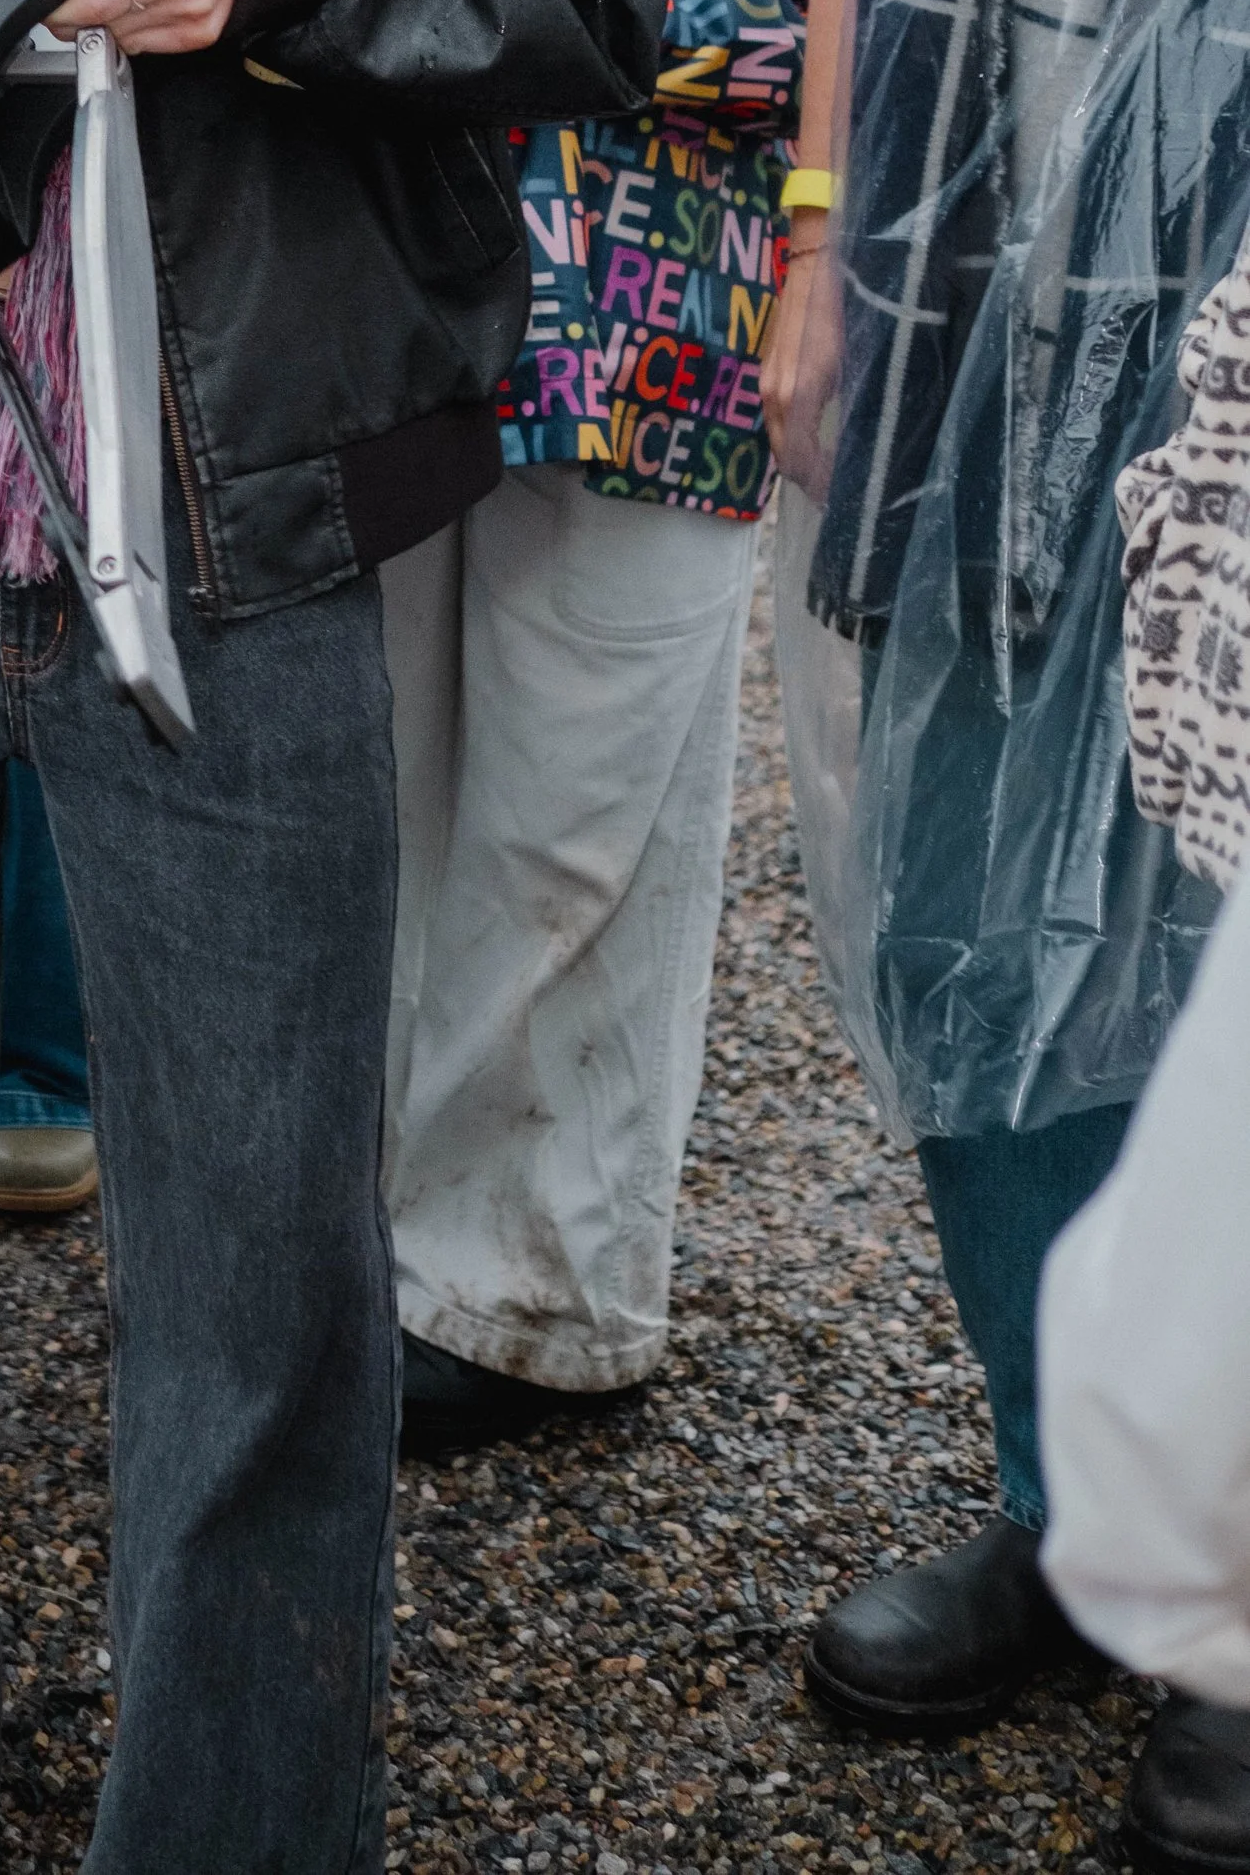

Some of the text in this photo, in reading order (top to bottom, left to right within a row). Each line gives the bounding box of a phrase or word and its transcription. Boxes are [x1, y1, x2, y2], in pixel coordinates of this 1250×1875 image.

[669, 188, 720, 266] SO
[600, 244, 724, 346] REAL
[701, 355, 763, 431] RE
[694, 427, 760, 501] SO
